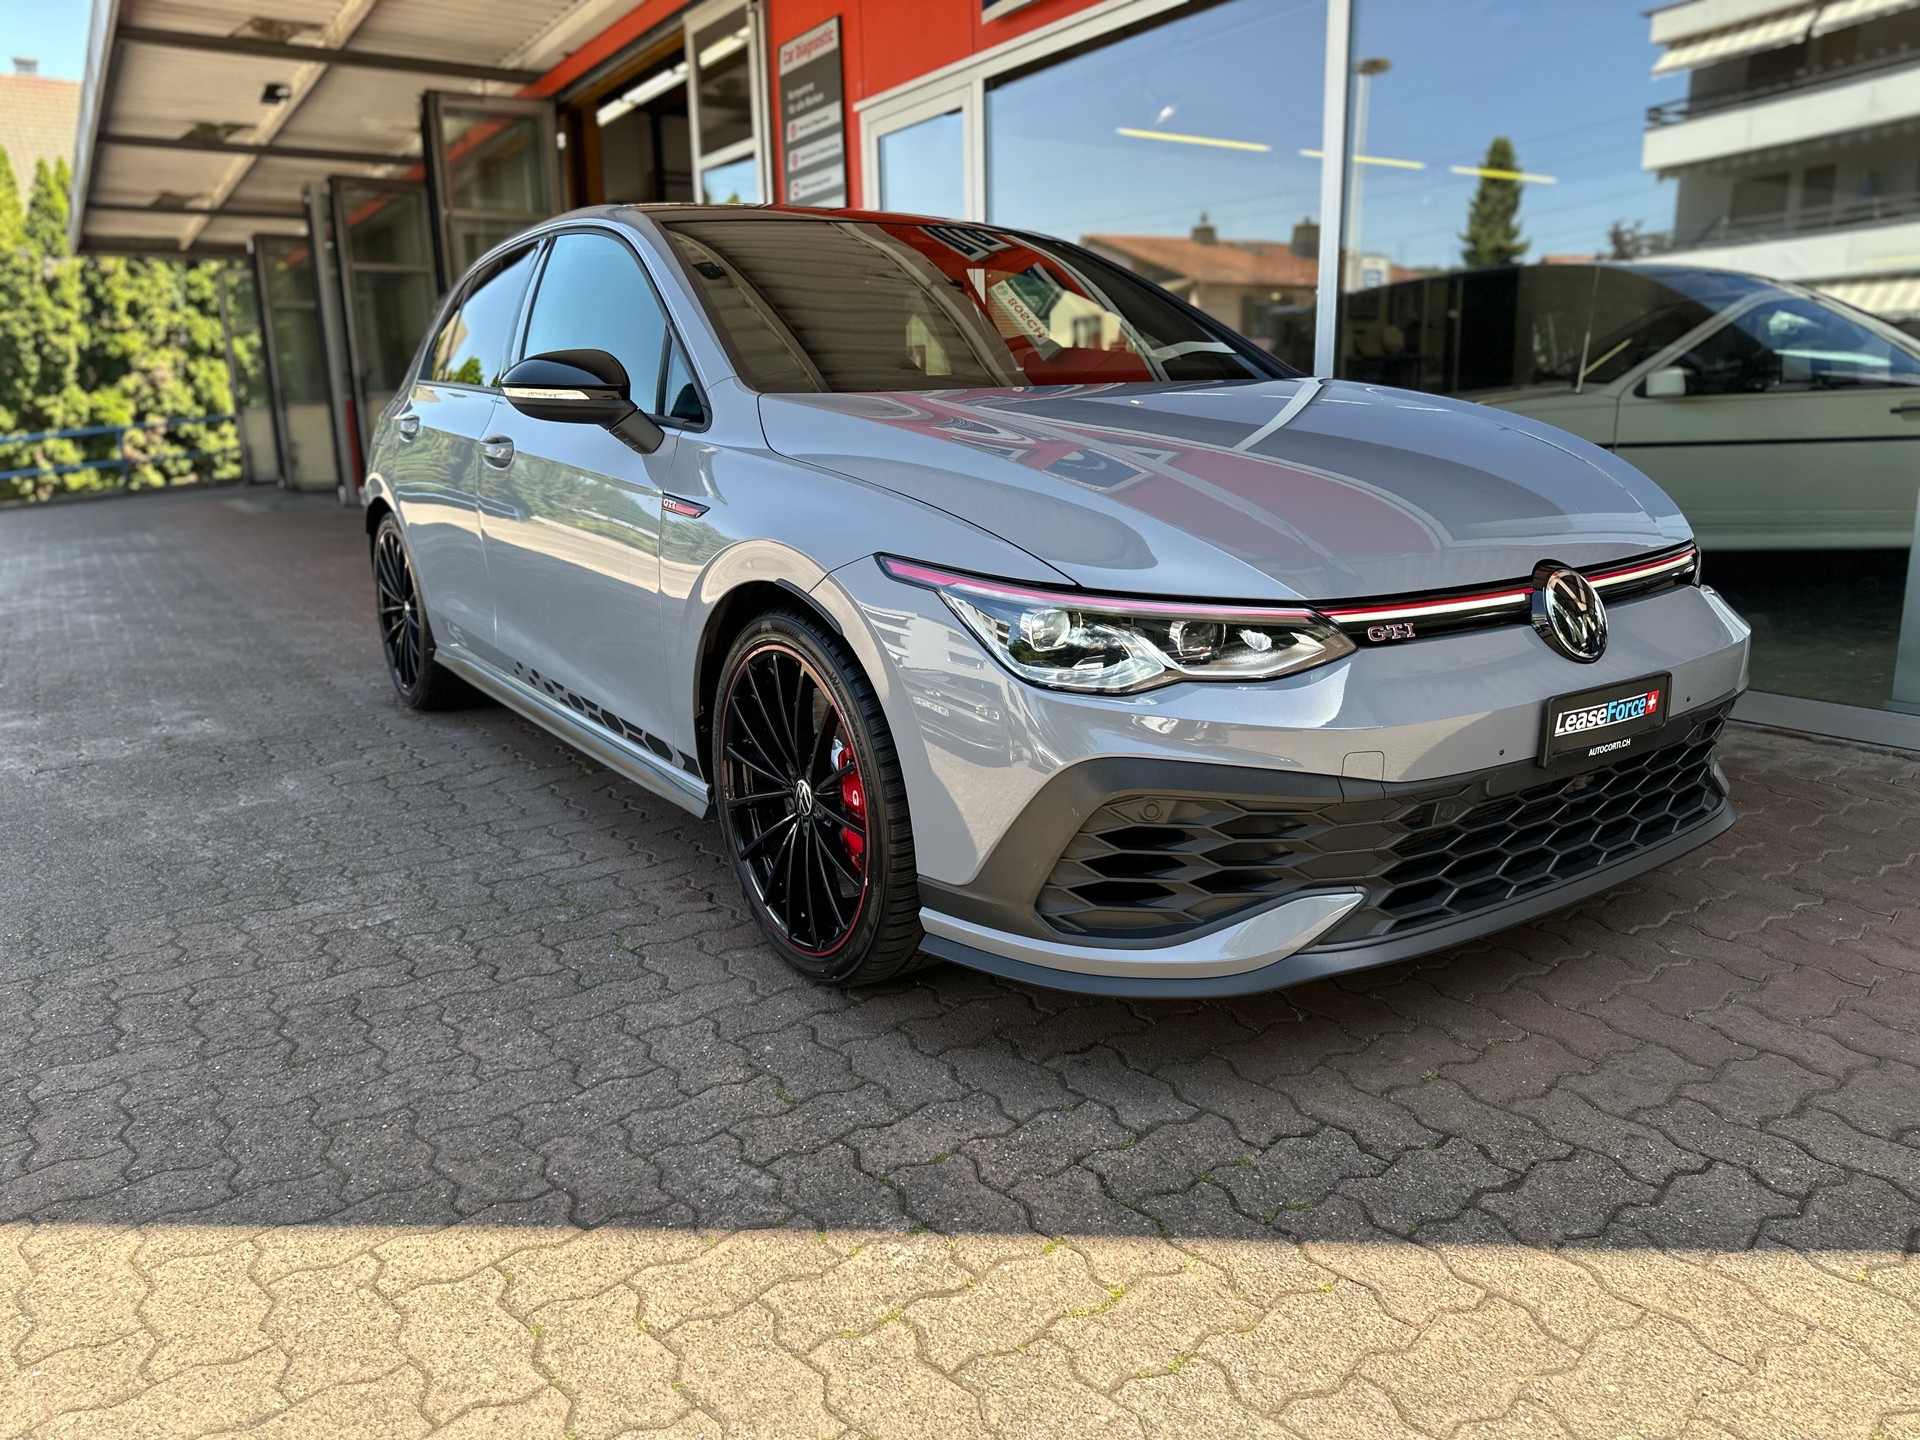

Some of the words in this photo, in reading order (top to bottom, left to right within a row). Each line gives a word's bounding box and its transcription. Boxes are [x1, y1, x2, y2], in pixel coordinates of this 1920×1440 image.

[663, 498, 677, 509] GTI
[1367, 622, 1416, 642] GTI
[1554, 696, 1647, 734] LeaseForce
[1588, 738, 1632, 757] AUTOCORTI.CH
